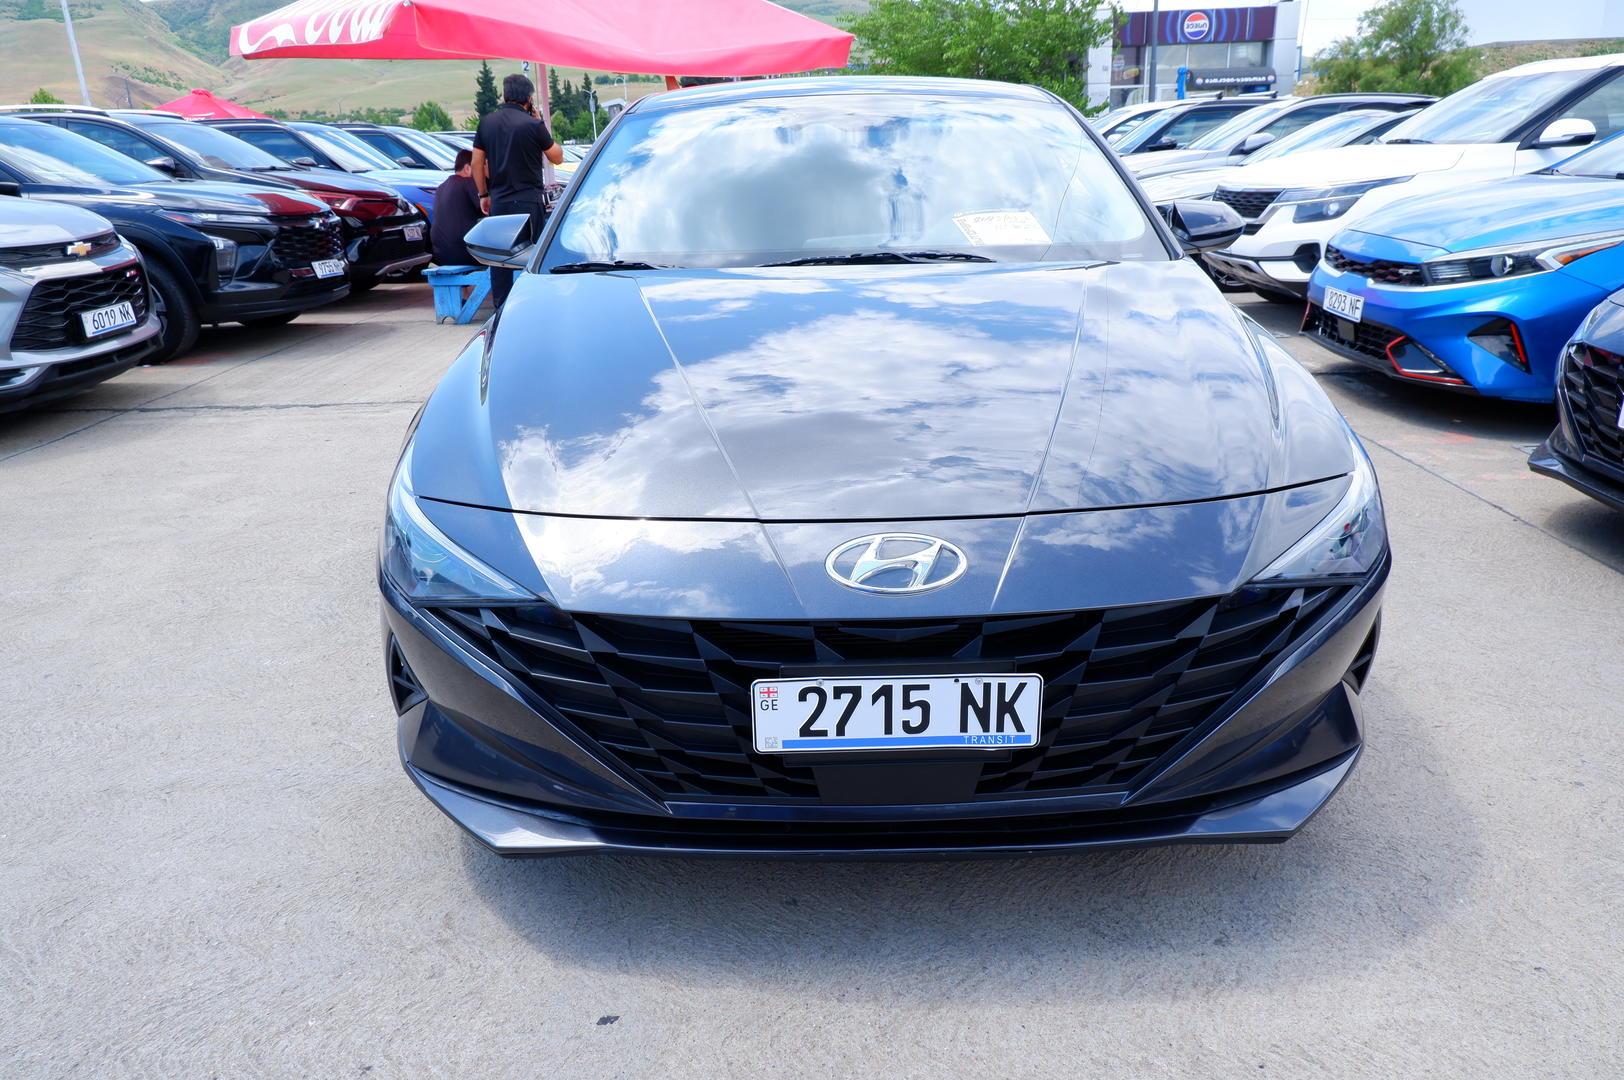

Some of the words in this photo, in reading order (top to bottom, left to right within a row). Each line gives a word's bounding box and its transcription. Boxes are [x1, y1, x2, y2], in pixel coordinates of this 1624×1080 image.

[522, 60, 530, 72] 2
[1329, 291, 1347, 311] 8293
[1348, 297, 1361, 316] NF
[92, 309, 116, 330] 6019
[119, 304, 133, 322] NK
[759, 699, 779, 711] GE
[797, 683, 931, 738] 2715
[959, 682, 1028, 733] NK
[963, 735, 1016, 744] TRANSIT
